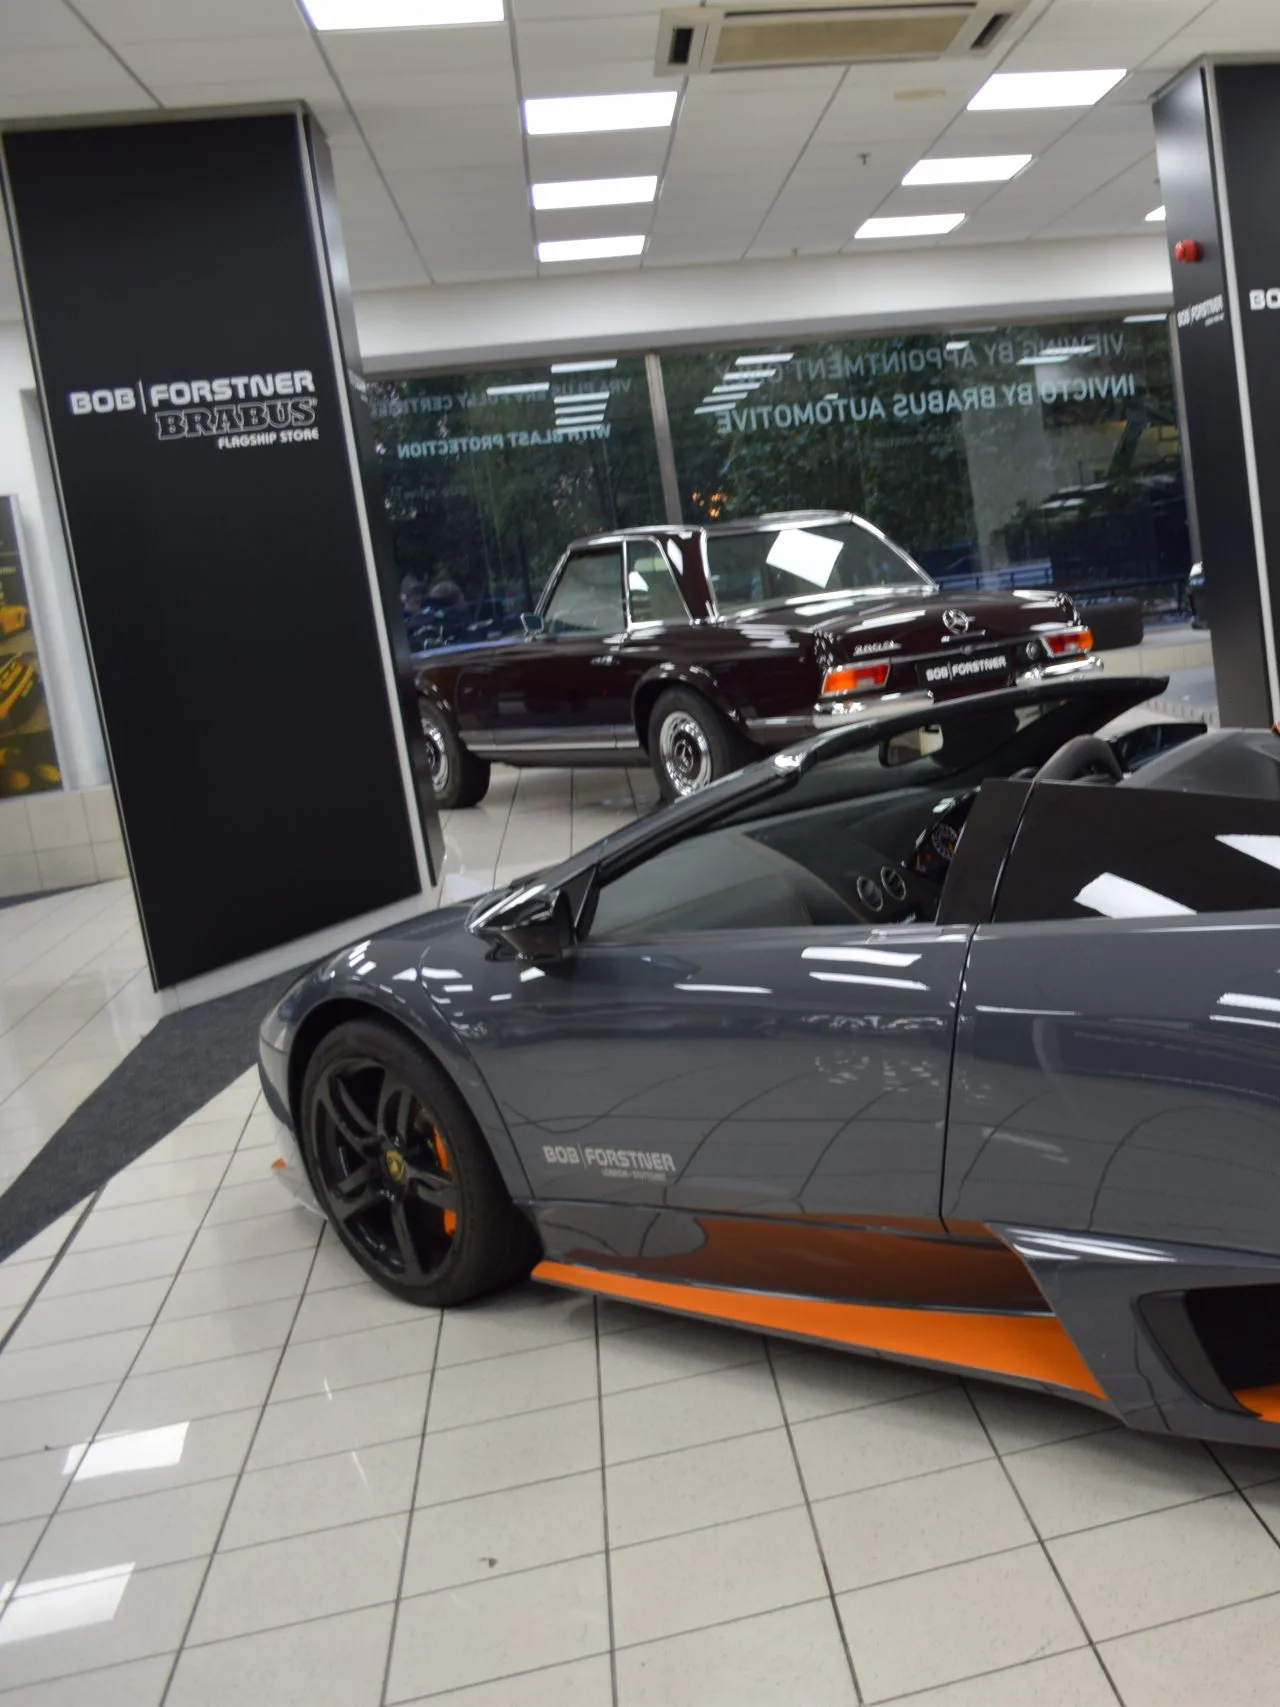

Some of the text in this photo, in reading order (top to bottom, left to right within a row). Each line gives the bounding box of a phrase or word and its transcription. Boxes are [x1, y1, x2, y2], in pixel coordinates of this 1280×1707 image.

[70, 387, 136, 415] BOB
[150, 370, 315, 407] FORSTNER
[155, 398, 315, 440] BRABUS
[218, 427, 319, 450] FLAGSHIP STORE
[926, 655, 1007, 682] BOB FORSTNER
[542, 1146, 676, 1172] BOB FORSTNER
